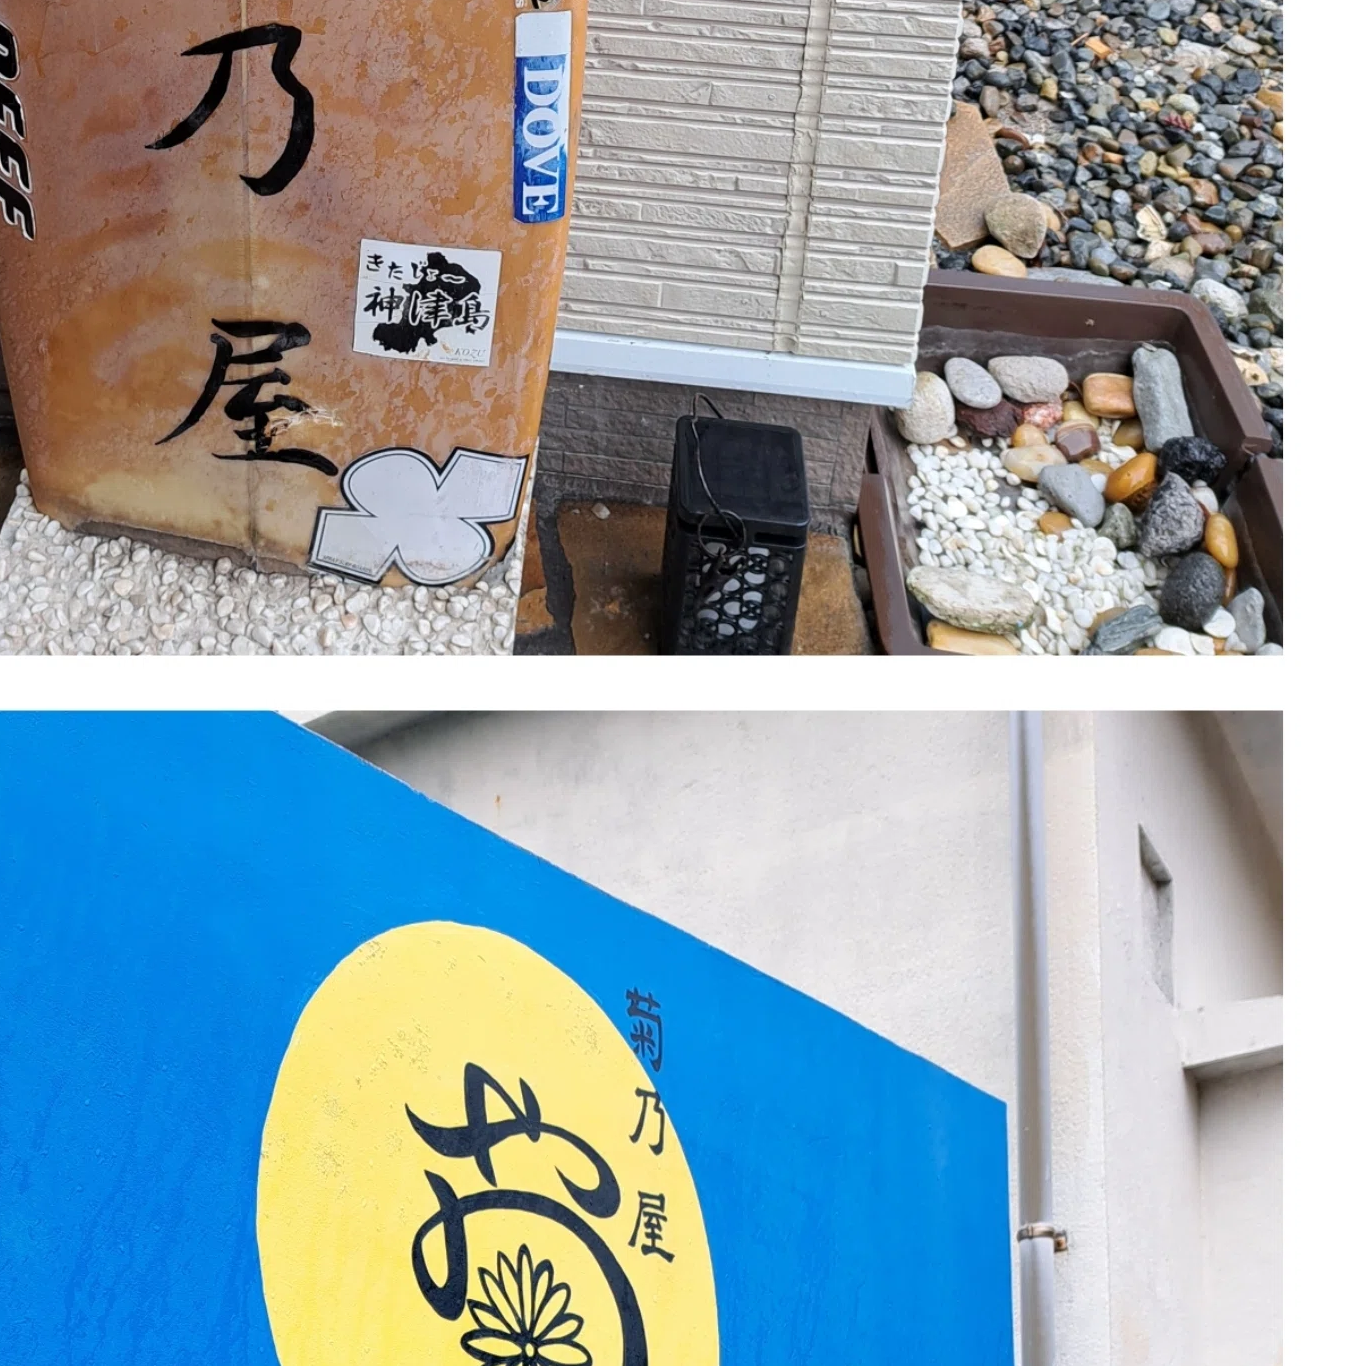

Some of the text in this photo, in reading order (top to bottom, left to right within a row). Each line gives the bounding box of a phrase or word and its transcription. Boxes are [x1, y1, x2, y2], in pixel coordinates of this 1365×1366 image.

[522, 63, 564, 215] DOVE
[363, 286, 491, 335] 神津島
[624, 986, 675, 1263] 菊乃屋
